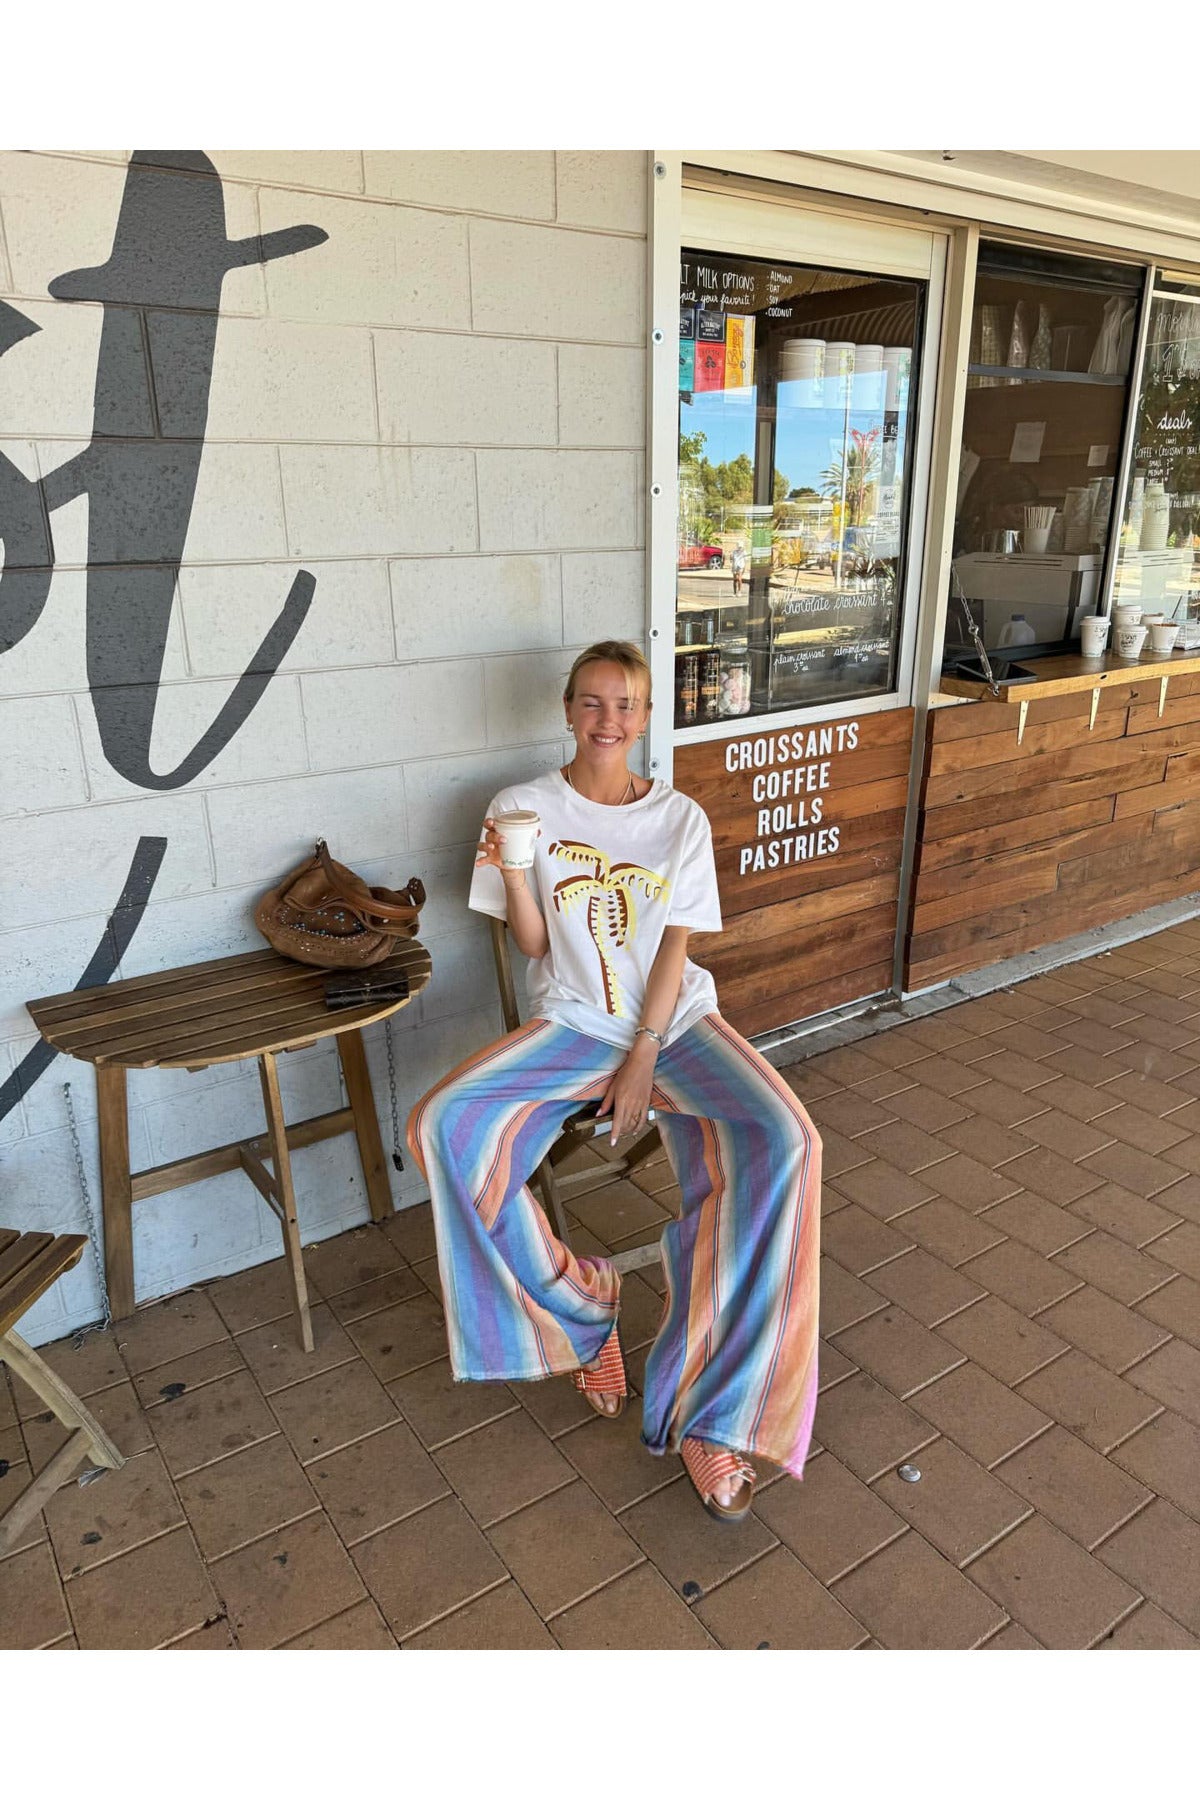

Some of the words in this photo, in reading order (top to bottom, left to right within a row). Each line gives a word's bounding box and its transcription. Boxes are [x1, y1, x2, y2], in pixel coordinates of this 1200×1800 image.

[697, 265, 718, 289] MILK
[700, 295, 719, 309] your
[1157, 409, 1193, 429] deals
[781, 596, 830, 615] chocolate
[833, 594, 877, 610] croissant
[773, 654, 795, 673] plain
[725, 722, 860, 773] CROISSANTS
[752, 762, 831, 803] COFFEE
[757, 797, 824, 837] ROLLS
[739, 827, 840, 876] PASTRIES
